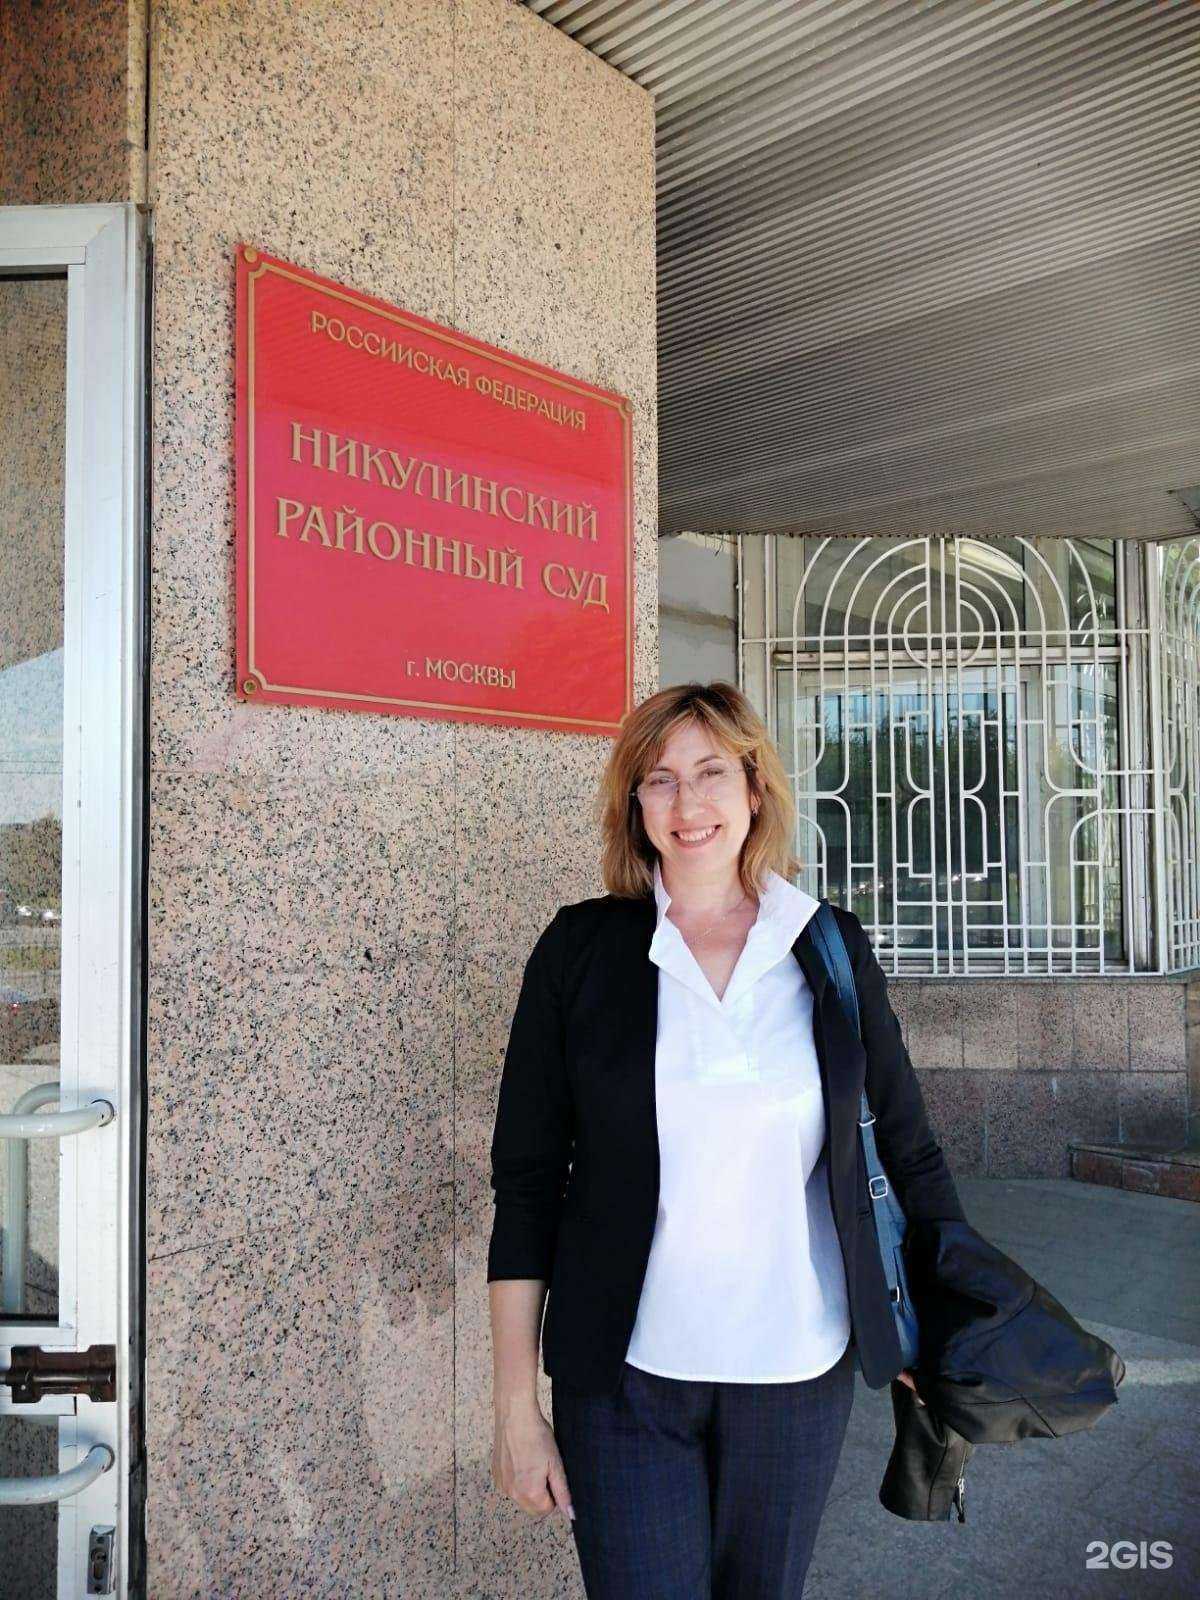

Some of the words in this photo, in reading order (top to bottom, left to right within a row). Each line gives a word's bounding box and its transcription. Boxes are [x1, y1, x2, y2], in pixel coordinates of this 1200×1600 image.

[475, 376, 586, 431] ФЕДЕРАЦИЯ
[290, 422, 599, 542] НИКУЛИНСКИЙ
[275, 497, 524, 590] РАЙОННЫЙ
[541, 562, 610, 614] СУД
[425, 657, 516, 689] МОСКВЫ
